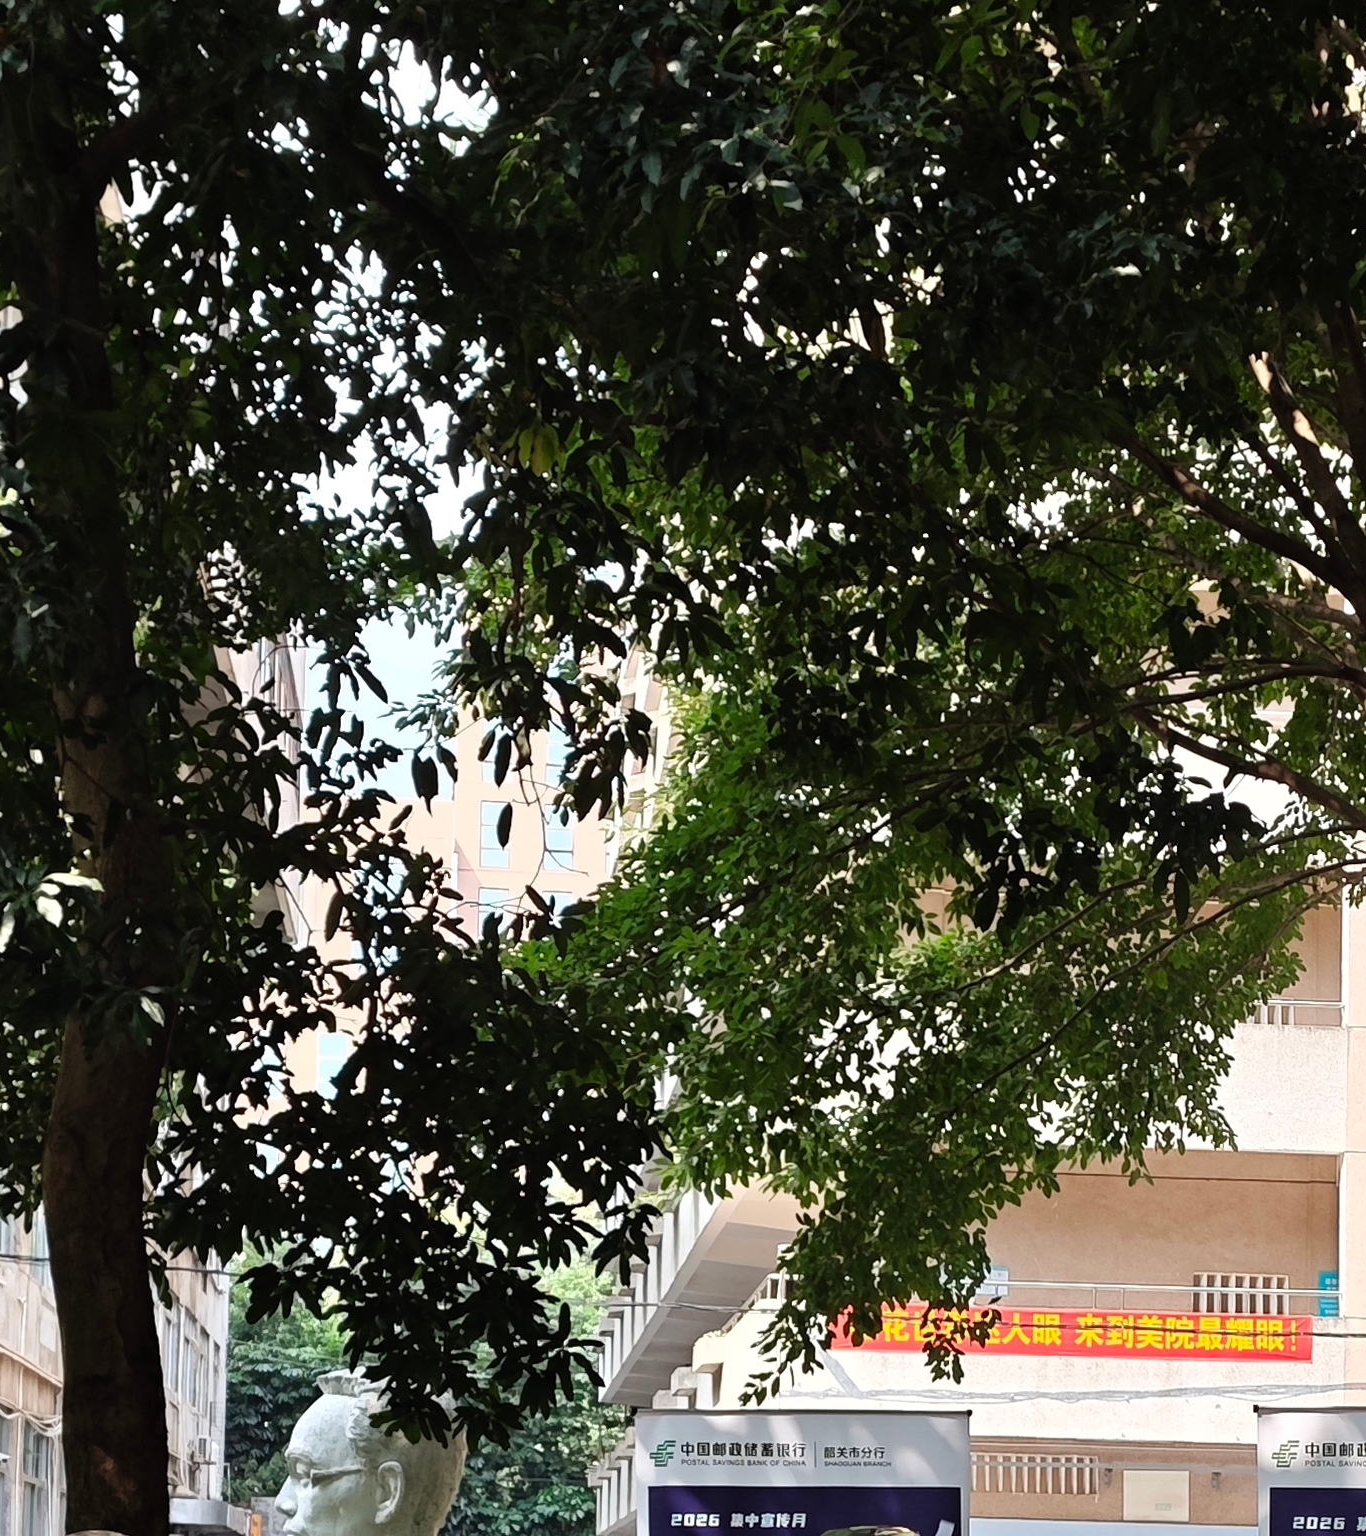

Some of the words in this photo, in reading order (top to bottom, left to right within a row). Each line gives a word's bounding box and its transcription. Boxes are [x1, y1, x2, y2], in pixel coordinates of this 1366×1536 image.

[680, 1441, 806, 1458] 中国邮政储蓄银行
[824, 1446, 886, 1460] 韶关市分行
[770, 1459, 781, 1467] OF
[1305, 1460, 1335, 1468] POSTAL
[671, 1513, 720, 1527] 2026
[1292, 1516, 1346, 1530] 2026
